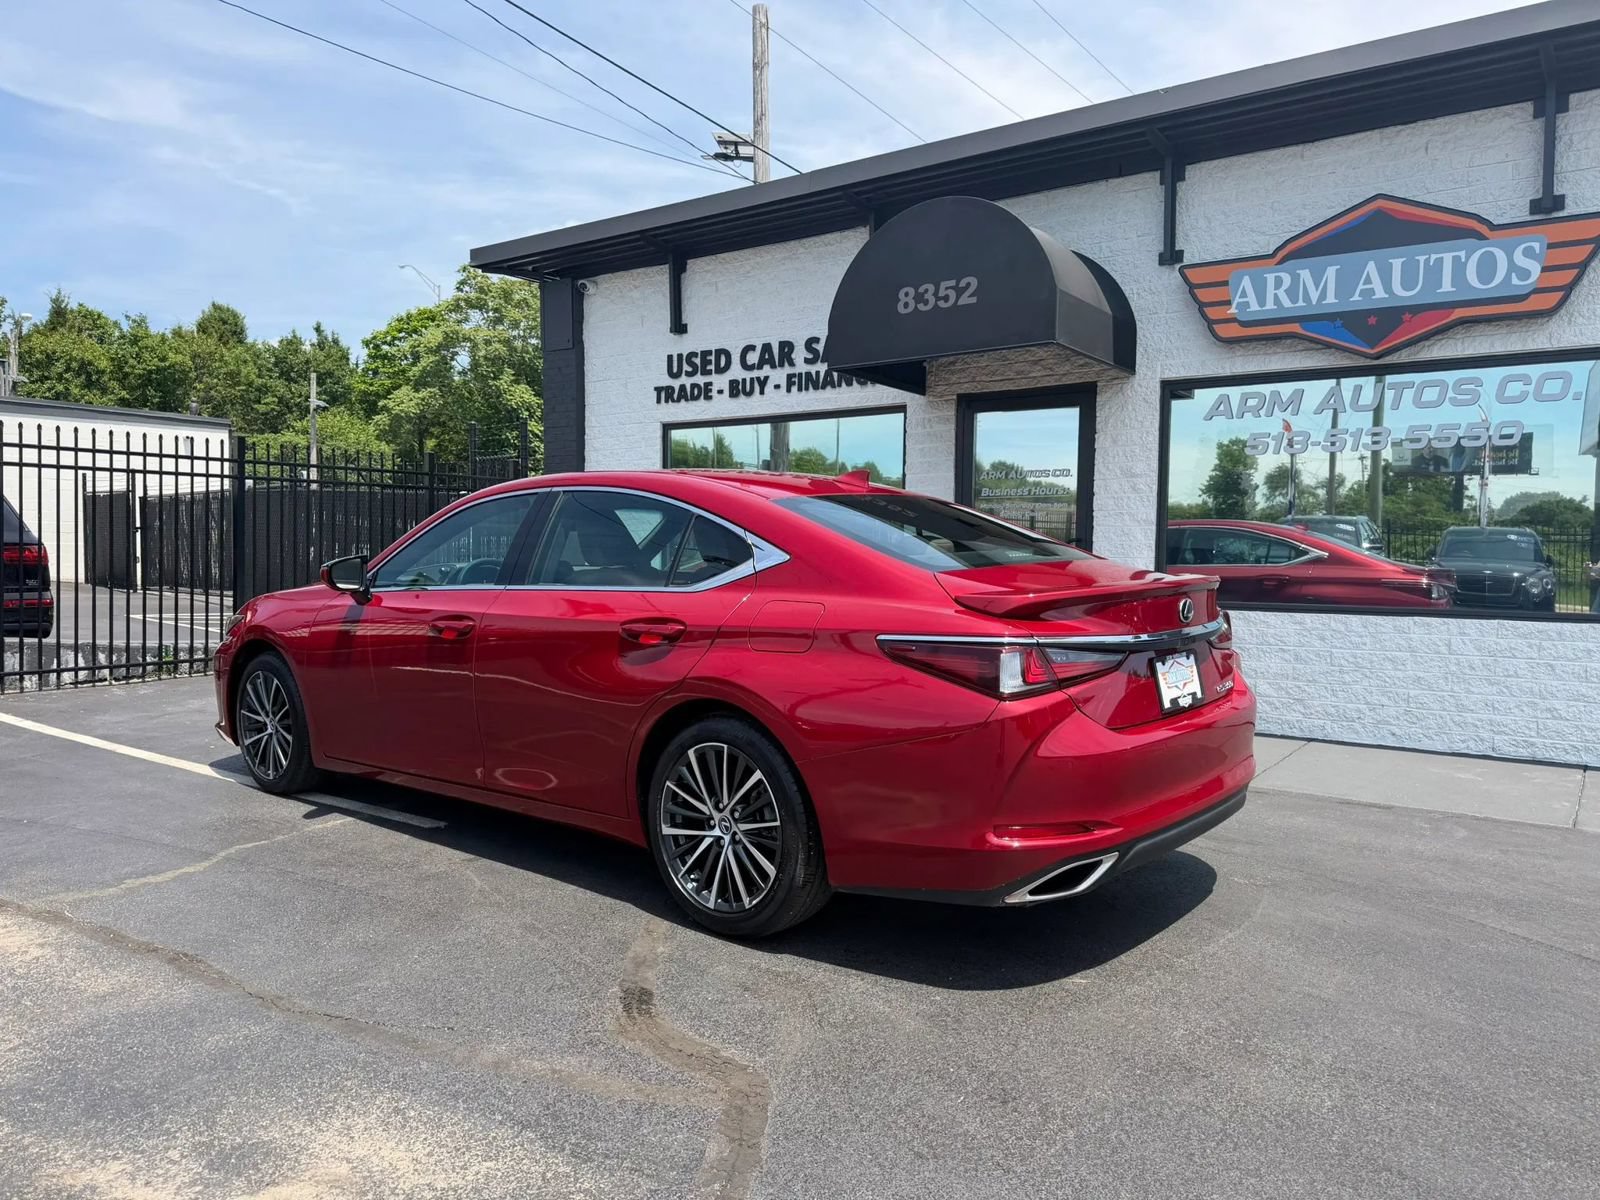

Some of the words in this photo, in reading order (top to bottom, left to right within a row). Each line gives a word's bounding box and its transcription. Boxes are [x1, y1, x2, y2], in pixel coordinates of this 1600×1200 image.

[897, 276, 978, 315] 8352
[1226, 265, 1341, 314] ARM
[1349, 241, 1542, 302] AUTOS
[666, 348, 732, 379] USED
[740, 340, 796, 371] CAR
[654, 381, 713, 404] TRADE
[728, 375, 770, 399] BUY
[1203, 388, 1304, 421] ARM
[1313, 376, 1483, 415] AUTOS
[1495, 370, 1583, 403] CO.
[1244, 419, 1525, 456] 513-513-5550
[980, 468, 1006, 481] ARM
[1008, 468, 1051, 480] AUTOS
[981, 487, 1029, 497] Business
